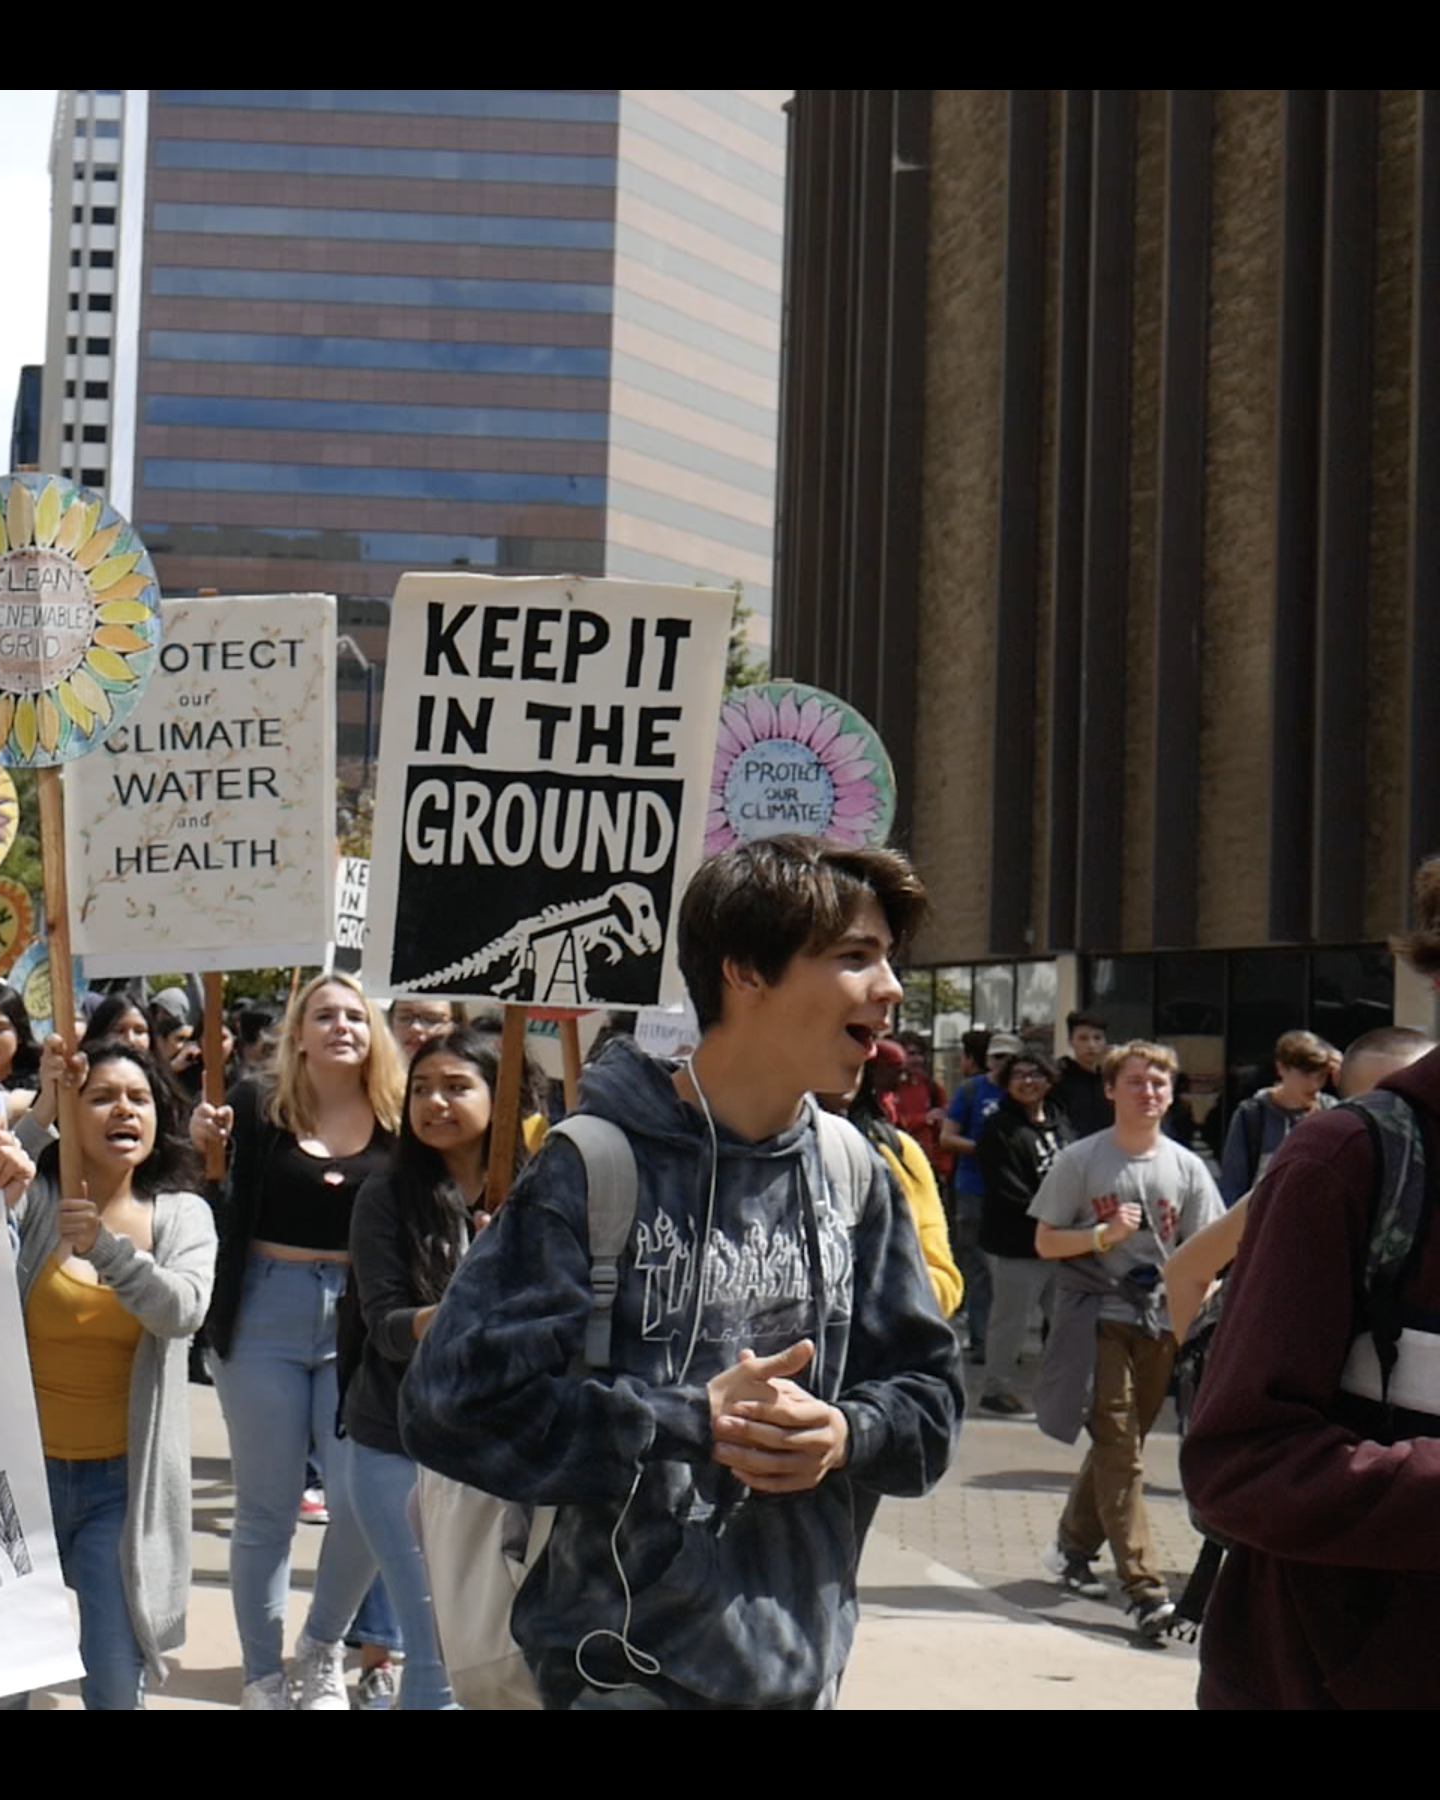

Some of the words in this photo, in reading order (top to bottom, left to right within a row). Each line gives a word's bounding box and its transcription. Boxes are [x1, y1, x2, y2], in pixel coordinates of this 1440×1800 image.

[160, 638, 305, 673] OTECT
[423, 601, 610, 684] KEEP
[625, 617, 691, 692] IT
[179, 692, 212, 707] our
[103, 717, 283, 754] CLIMATE
[414, 695, 495, 755] IN
[525, 700, 683, 768] THE
[113, 766, 280, 807] WATER
[745, 760, 823, 784] PROTECT
[764, 786, 800, 802] OUR
[177, 811, 211, 829] and
[404, 778, 676, 875] GROUND
[740, 801, 823, 823] CLIMATE
[115, 838, 278, 875] HEALTH
[345, 858, 369, 887] KE
[340, 890, 360, 911] IN
[635, 1207, 853, 1336] THRASHR
